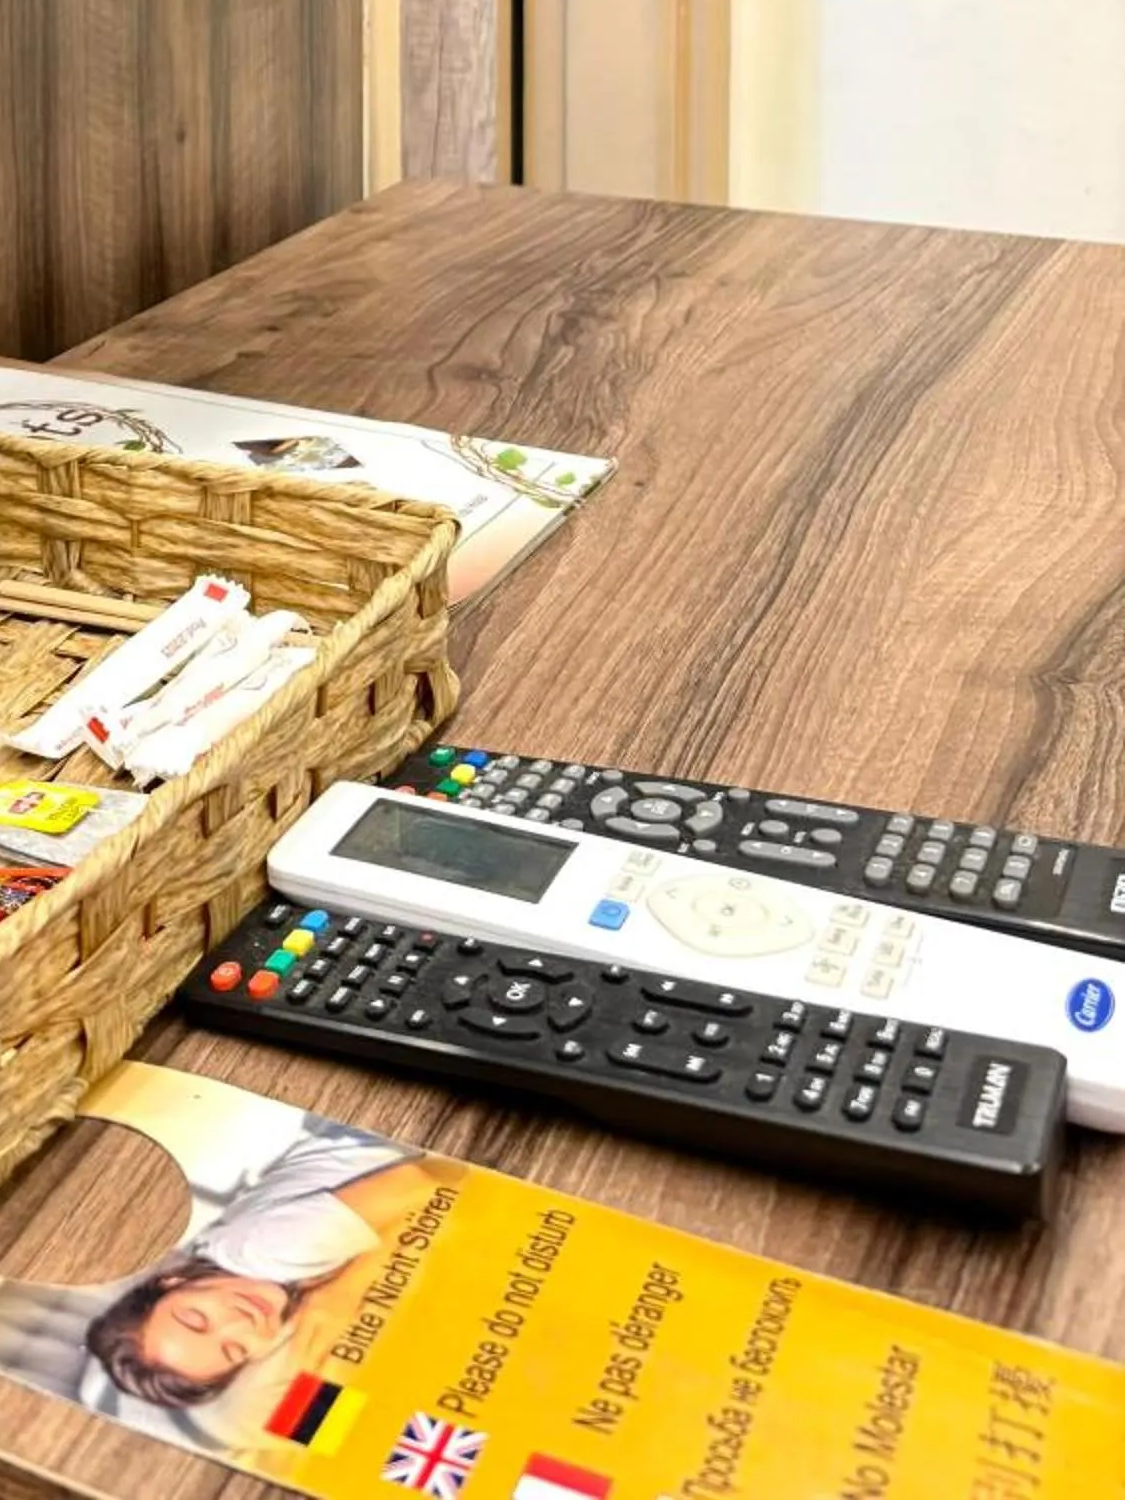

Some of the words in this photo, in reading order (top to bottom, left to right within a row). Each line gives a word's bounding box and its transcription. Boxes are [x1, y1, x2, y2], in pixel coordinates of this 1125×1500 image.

[505, 980, 531, 1000] OK
[1075, 983, 1102, 1027] Carrier
[515, 1208, 576, 1274] disturb
[331, 1311, 385, 1365] Bitte
[362, 1251, 421, 1311] Nicht
[398, 1186, 460, 1251] Stören
[506, 1271, 544, 1308] not
[482, 1309, 525, 1339] do
[608, 1262, 684, 1351] déranger
[729, 1277, 802, 1376] беспокоить
[436, 1341, 509, 1419] Please
[598, 1353, 643, 1401] pas
[731, 1376, 764, 1405] не
[852, 1344, 922, 1462] Molestar
[572, 1398, 624, 1435] Ne
[679, 1407, 754, 1500] Просьба
